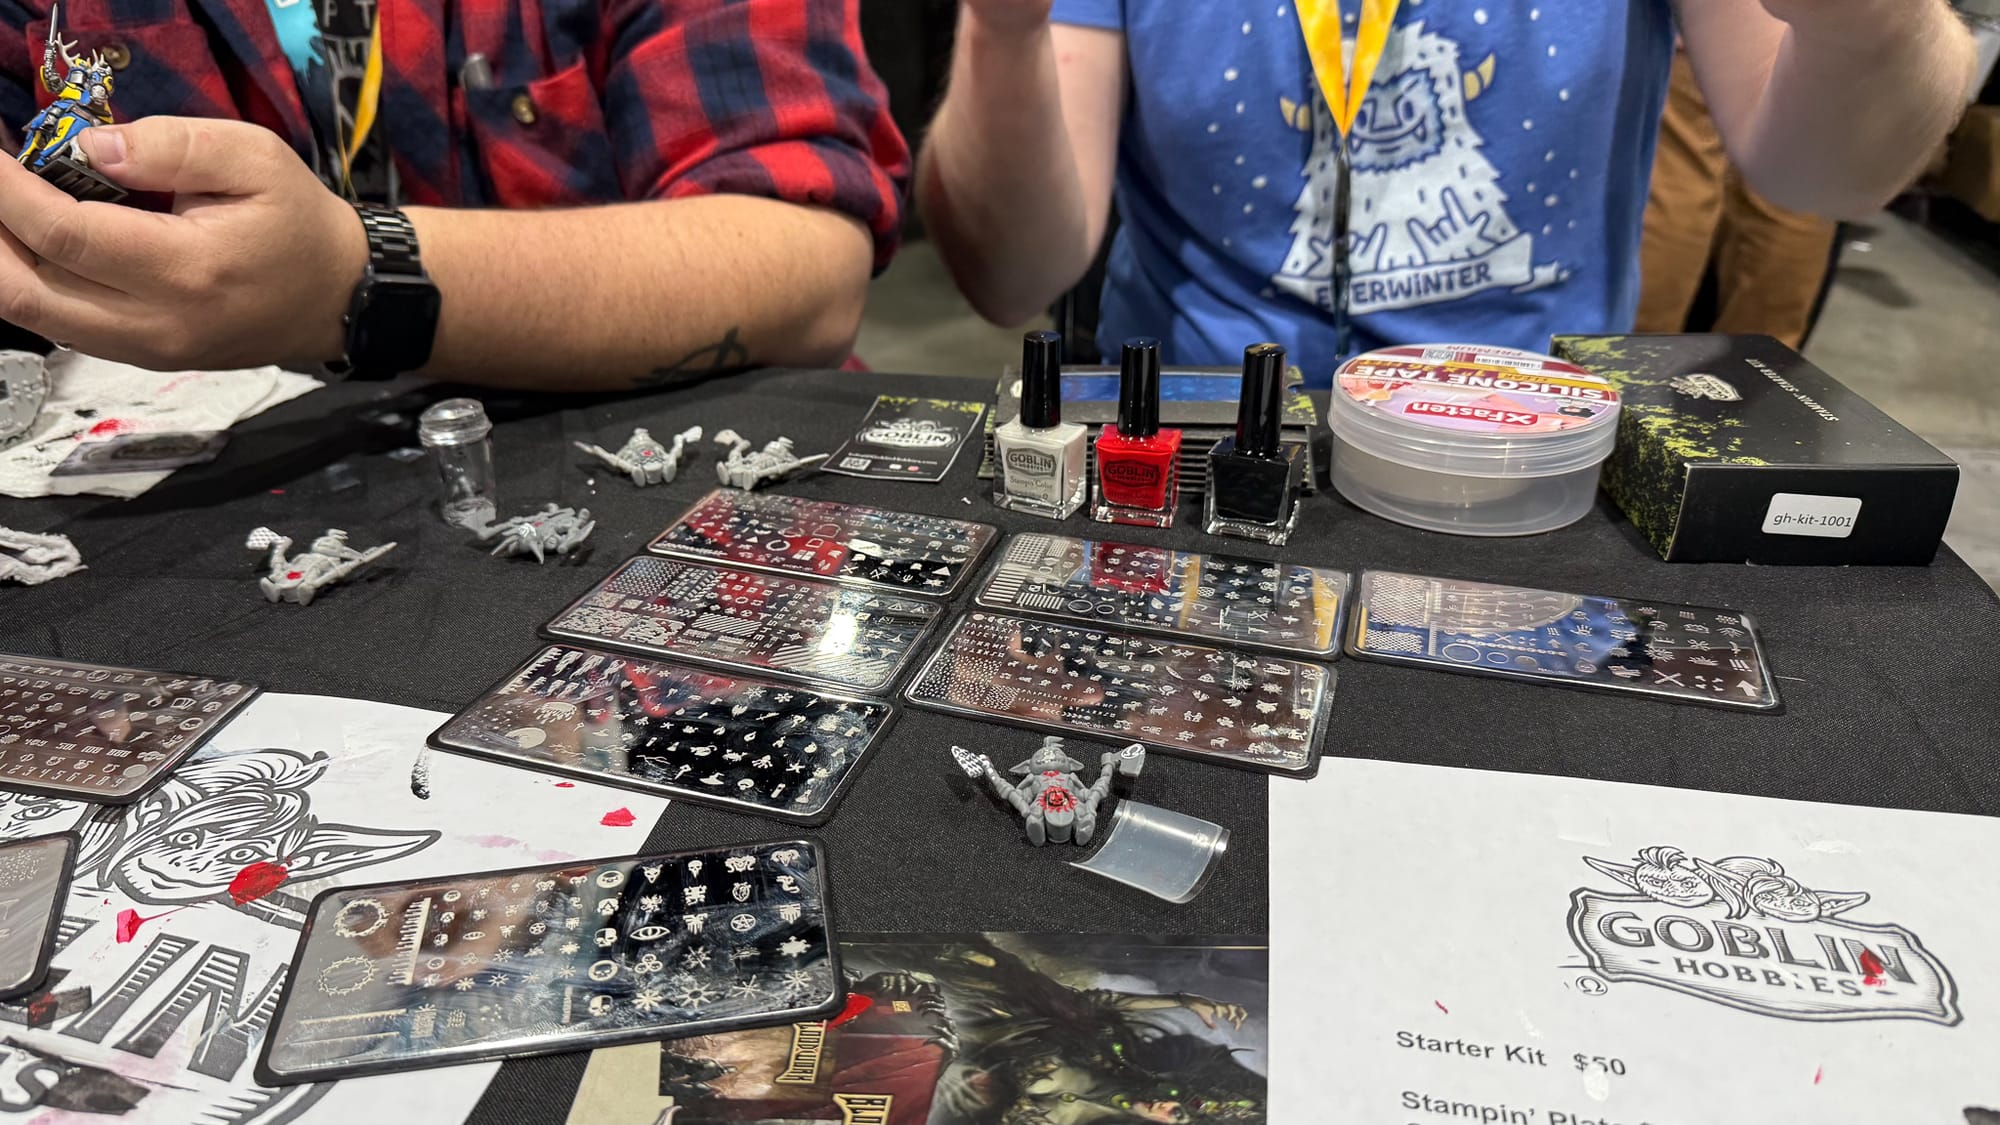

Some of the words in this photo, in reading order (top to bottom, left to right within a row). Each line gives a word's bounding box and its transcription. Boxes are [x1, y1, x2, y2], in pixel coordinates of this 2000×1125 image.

[1354, 366, 1440, 382] TAPE
[1449, 373, 1604, 399] SILICONE
[1412, 402, 1532, 425] XFasten
[869, 431, 947, 442] GOBLIN
[1010, 453, 1051, 469] GOBLIN
[1108, 465, 1155, 479] GOBLIN
[1773, 513, 1852, 528] gh-kit-1001
[1598, 911, 1917, 985] GOBLIN
[783, 1021, 825, 1083] LOODWORK
[1396, 1030, 1495, 1059] Starter
[1505, 1044, 1548, 1067] Kit
[1573, 1052, 1627, 1076] $50
[1401, 1090, 1535, 1125] Stampin'
